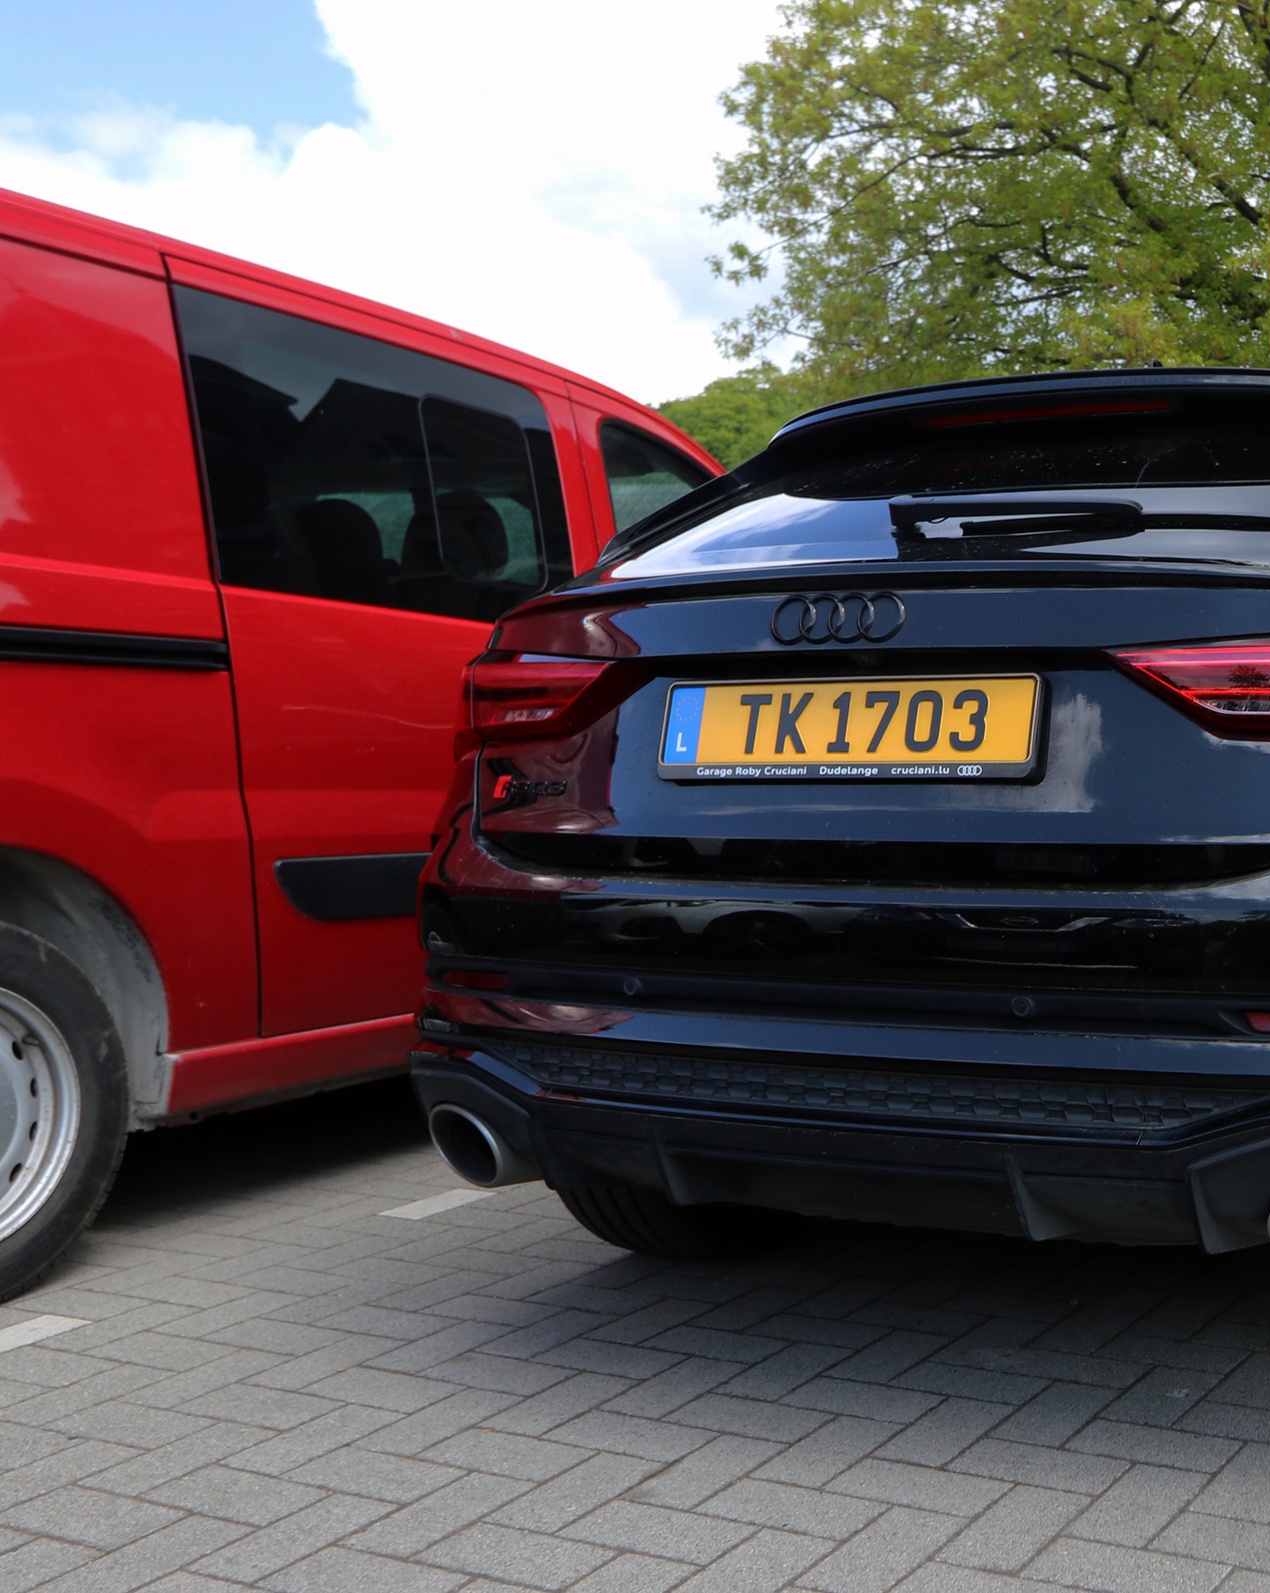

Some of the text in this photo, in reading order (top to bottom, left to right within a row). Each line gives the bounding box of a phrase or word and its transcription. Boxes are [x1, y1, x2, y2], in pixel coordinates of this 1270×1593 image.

[675, 732, 687, 753] L
[696, 765, 950, 777] Garage Roby Cruciani Dudelange cruciani.lu
